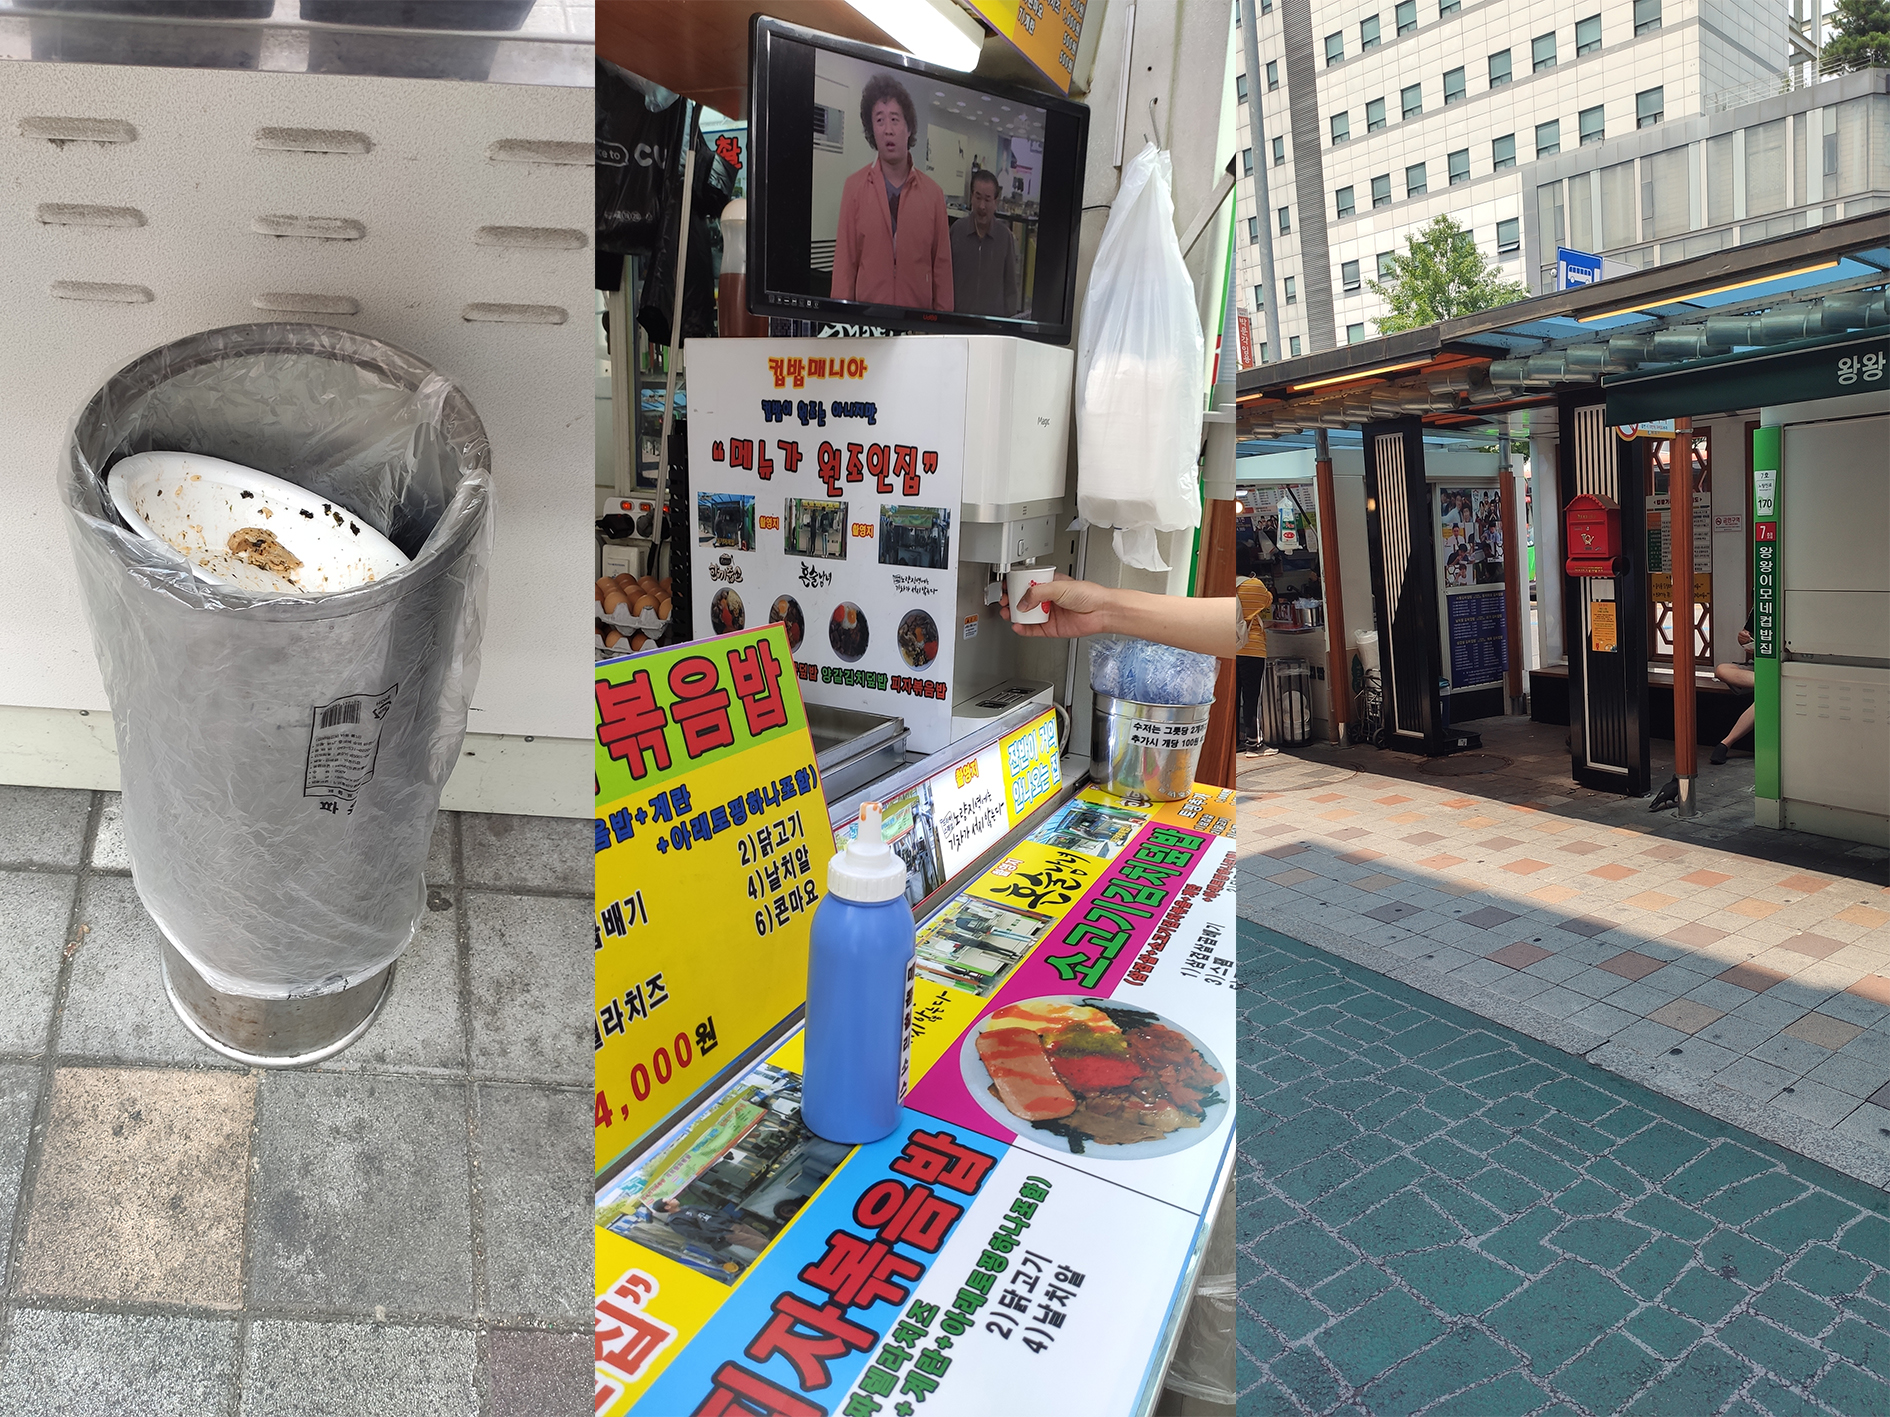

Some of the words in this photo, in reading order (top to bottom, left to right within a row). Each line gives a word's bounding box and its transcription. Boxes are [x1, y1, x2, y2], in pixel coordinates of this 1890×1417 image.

[609, 149, 621, 160] to
[634, 143, 667, 170] CU
[768, 356, 868, 389] 컵밥매니아
[1836, 351, 1887, 385] 왕왕
[761, 399, 793, 423] 컵밥이
[797, 399, 826, 427] 원조는
[831, 400, 878, 426] 아니지만
[759, 515, 780, 531] 촬영지
[1758, 498, 1773, 509] 170
[851, 523, 875, 539] 촬영지
[1758, 546, 1774, 656] 왕왕이모네컵밥집
[793, 661, 819, 682] 덮밥
[890, 675, 948, 701] 피자볶음밥
[1038, 716, 1058, 754] 거의
[1131, 734, 1159, 747] 추가시
[1161, 739, 1179, 748] 개당
[1133, 722, 1161, 734] 수저는
[1163, 726, 1189, 736] 그릇당
[954, 758, 979, 789] 촬영지
[1012, 762, 1050, 814] 안나오는
[1049, 750, 1061, 785] 집
[656, 764, 818, 854] +아래토핑하나포함)
[737, 810, 805, 866] 2)닭고기
[747, 844, 810, 901] 4)날치알
[989, 851, 1091, 910] 혼술남녀
[755, 878, 819, 937] 6)콘마요
[1044, 827, 1207, 989] 소고기김치덮밥
[985, 1249, 1054, 1341] 2)닭고기
[1021, 1263, 1087, 1354] 4)날치알
